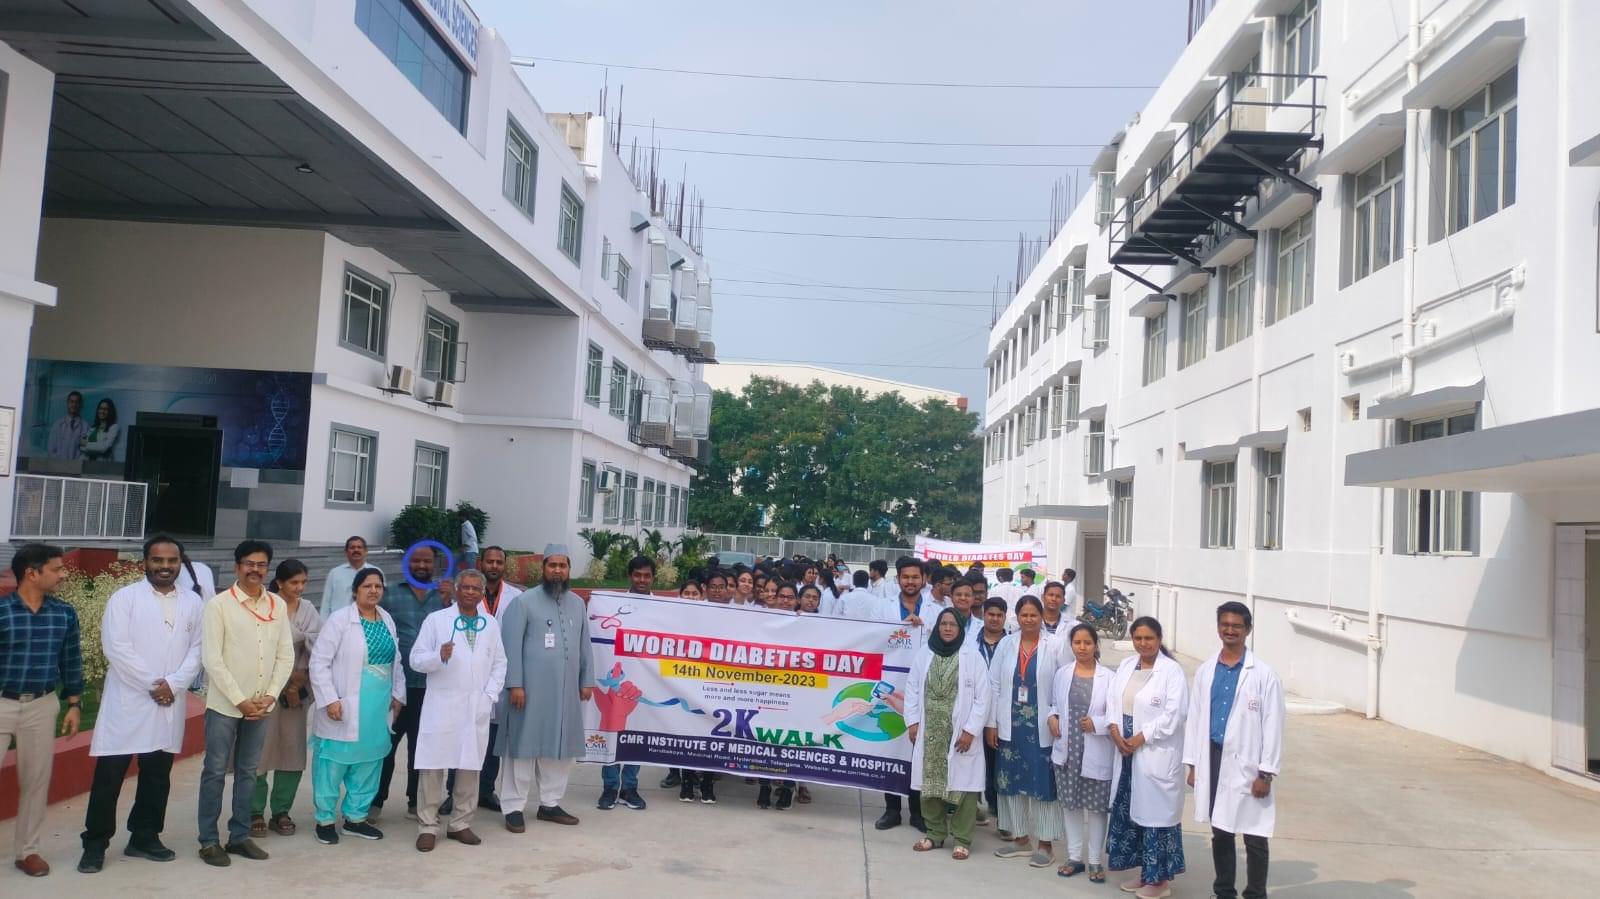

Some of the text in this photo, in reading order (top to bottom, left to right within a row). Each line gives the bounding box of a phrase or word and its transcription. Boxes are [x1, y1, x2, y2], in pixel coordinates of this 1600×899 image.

[927, 551, 959, 561] WORLD
[1007, 551, 1025, 561] DAY
[623, 633, 864, 674] WORLD DIABETES DAY
[672, 663, 816, 687] 14th November-2023
[755, 698, 789, 706] happiness
[711, 708, 844, 749] 2K WALK
[619, 734, 906, 775] CMR INSTITUTE OF MEDICAL SCIENCES & HOSPITAL
